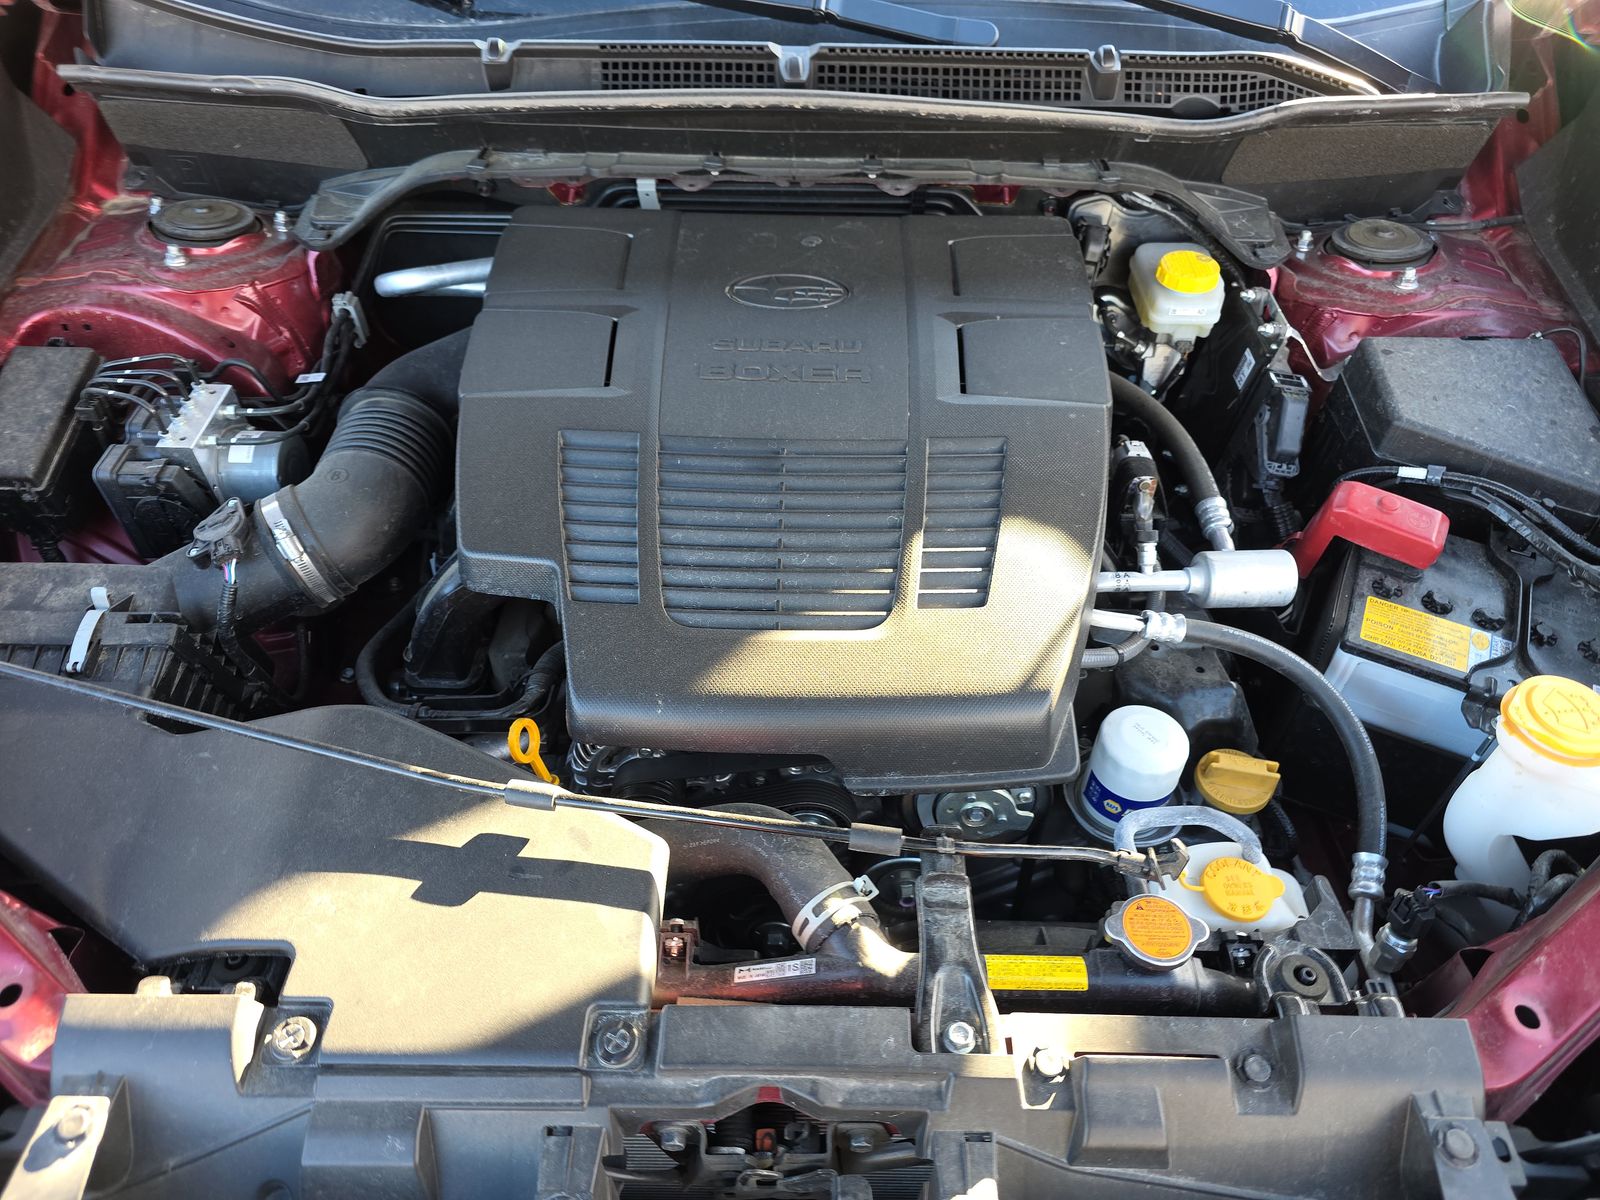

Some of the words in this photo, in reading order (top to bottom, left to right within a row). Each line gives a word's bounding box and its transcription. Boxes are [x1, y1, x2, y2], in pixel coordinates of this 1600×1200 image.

[711, 338, 862, 353] SUBARU
[699, 363, 872, 383] BOXER
[1370, 598, 1399, 610] DANGER
[1366, 618, 1393, 630] POISON
